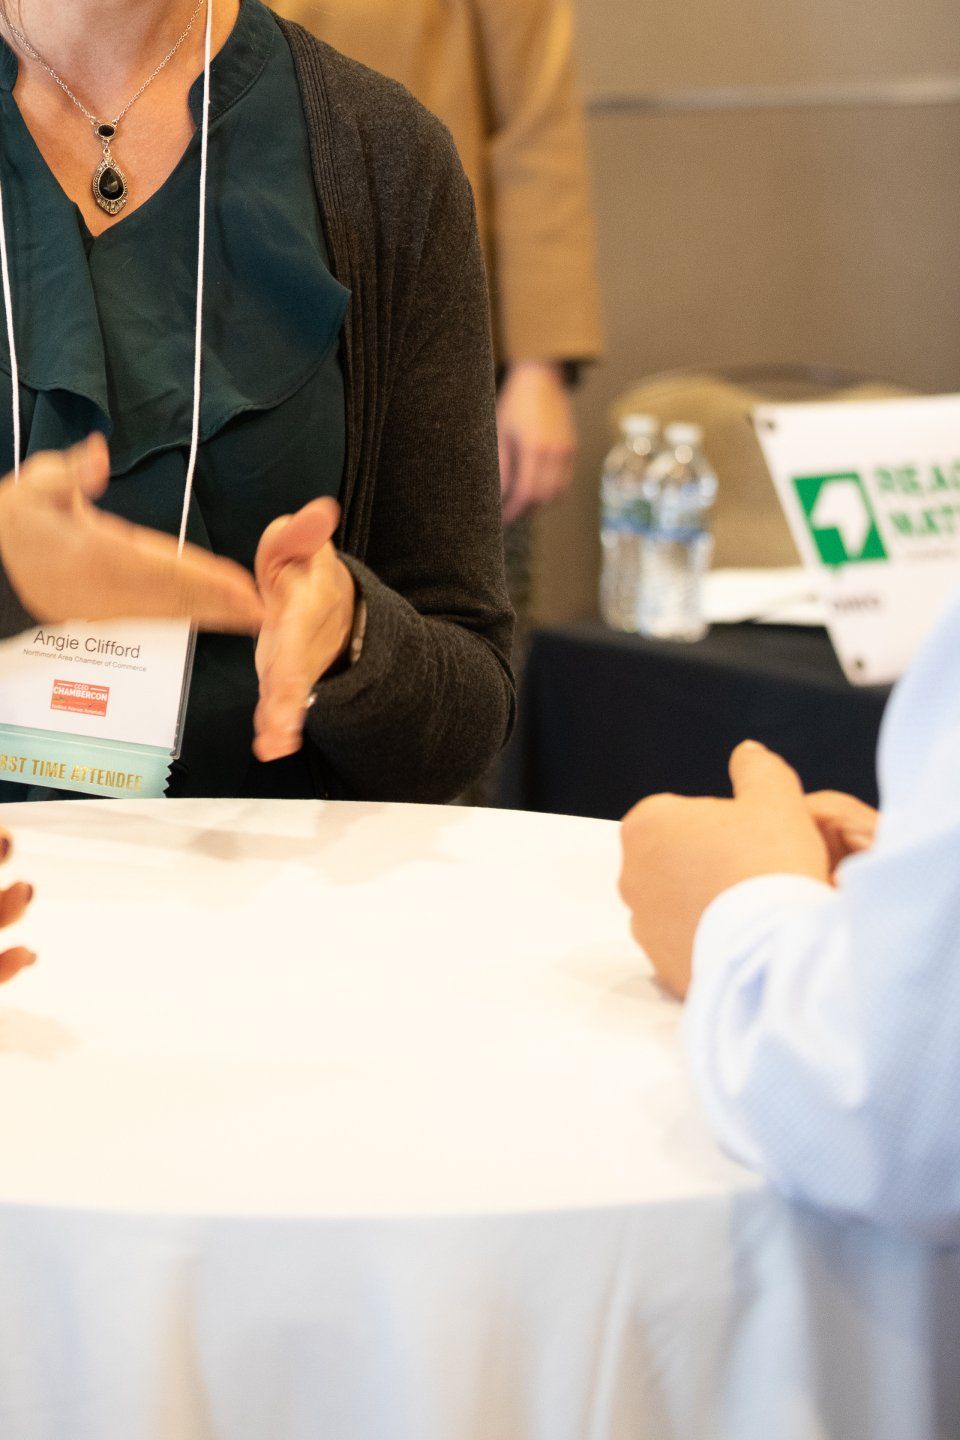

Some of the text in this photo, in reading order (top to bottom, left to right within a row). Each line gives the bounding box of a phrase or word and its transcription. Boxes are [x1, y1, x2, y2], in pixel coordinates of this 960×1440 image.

[33, 630, 141, 659] Angie Clifford
[74, 656, 103, 666] Chamber
[112, 662, 147, 672] Commerce
[53, 686, 108, 702] CHAMBERCON
[32, 759, 67, 779] TIME
[70, 764, 143, 792] ATTENDEE
